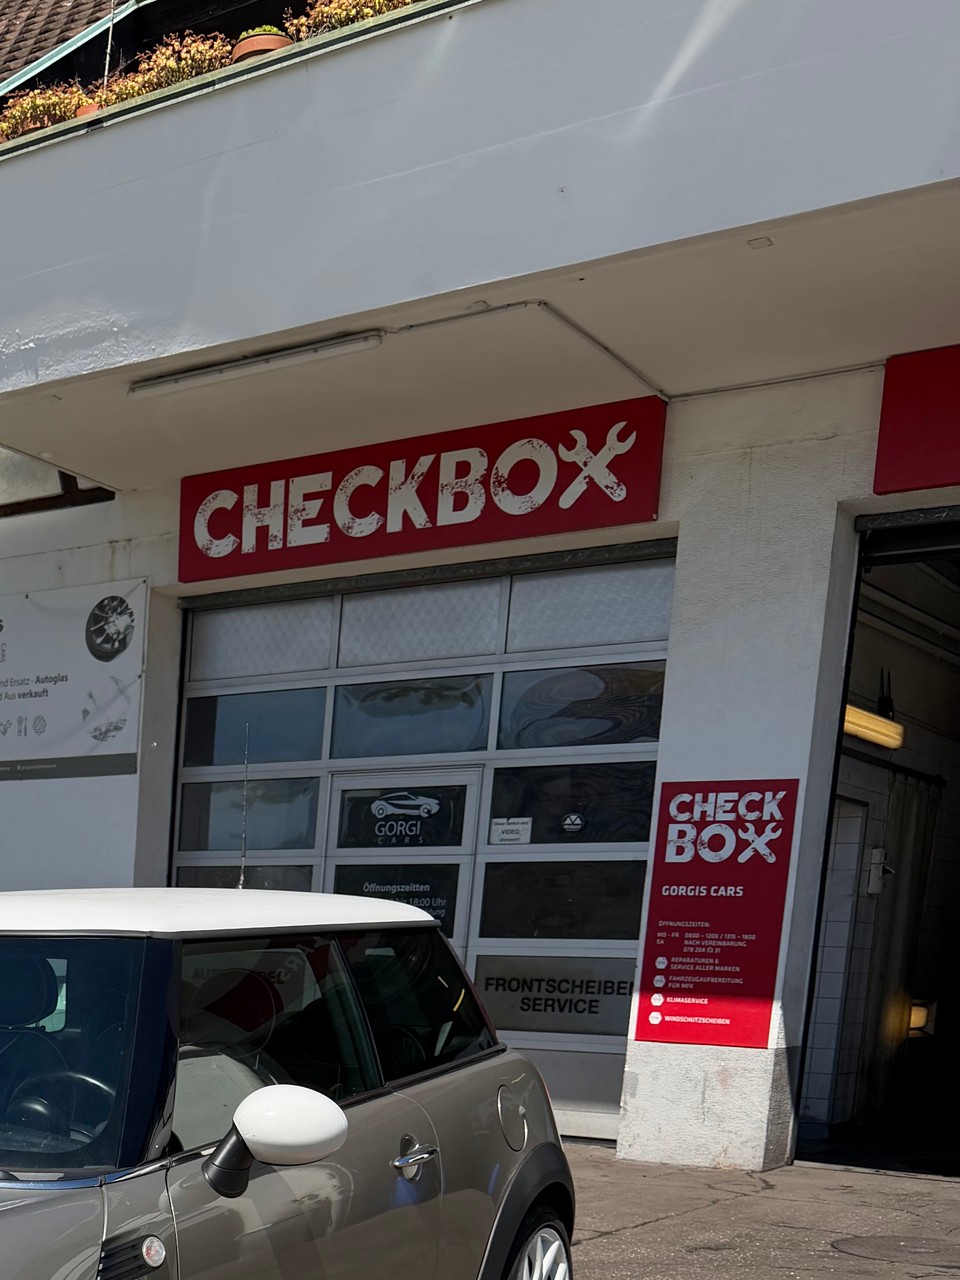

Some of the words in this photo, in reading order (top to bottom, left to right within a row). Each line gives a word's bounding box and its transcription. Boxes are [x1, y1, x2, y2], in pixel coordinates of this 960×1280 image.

[193, 421, 637, 558] CHECKBOX
[10, 677, 30, 687] Ersatz
[35, 673, 68, 685] Autoglas
[4, 691, 17, 701] Aus
[18, 688, 49, 699] verkauft
[669, 791, 788, 822] CHECK
[375, 820, 421, 836] GORGI
[664, 822, 783, 864] BOX
[363, 881, 430, 894] Öffnungszeitten
[661, 885, 707, 896] GORGIS
[710, 885, 744, 897] CARS
[409, 897, 431, 907] 18:00
[431, 896, 447, 907] Uhr
[658, 920, 711, 928] ÖFFNUNGSZEITEN:
[670, 956, 714, 964] REPARATUREN
[670, 963, 695, 971] SERVICE
[695, 964, 714, 972] ALLER
[714, 965, 740, 973] MARKEN
[668, 975, 744, 984] FAHRZEUGAUFBEREITUNG
[519, 997, 600, 1015] SERVICE
[664, 1015, 730, 1024] WINDSCHUTZSCHEIBEN
